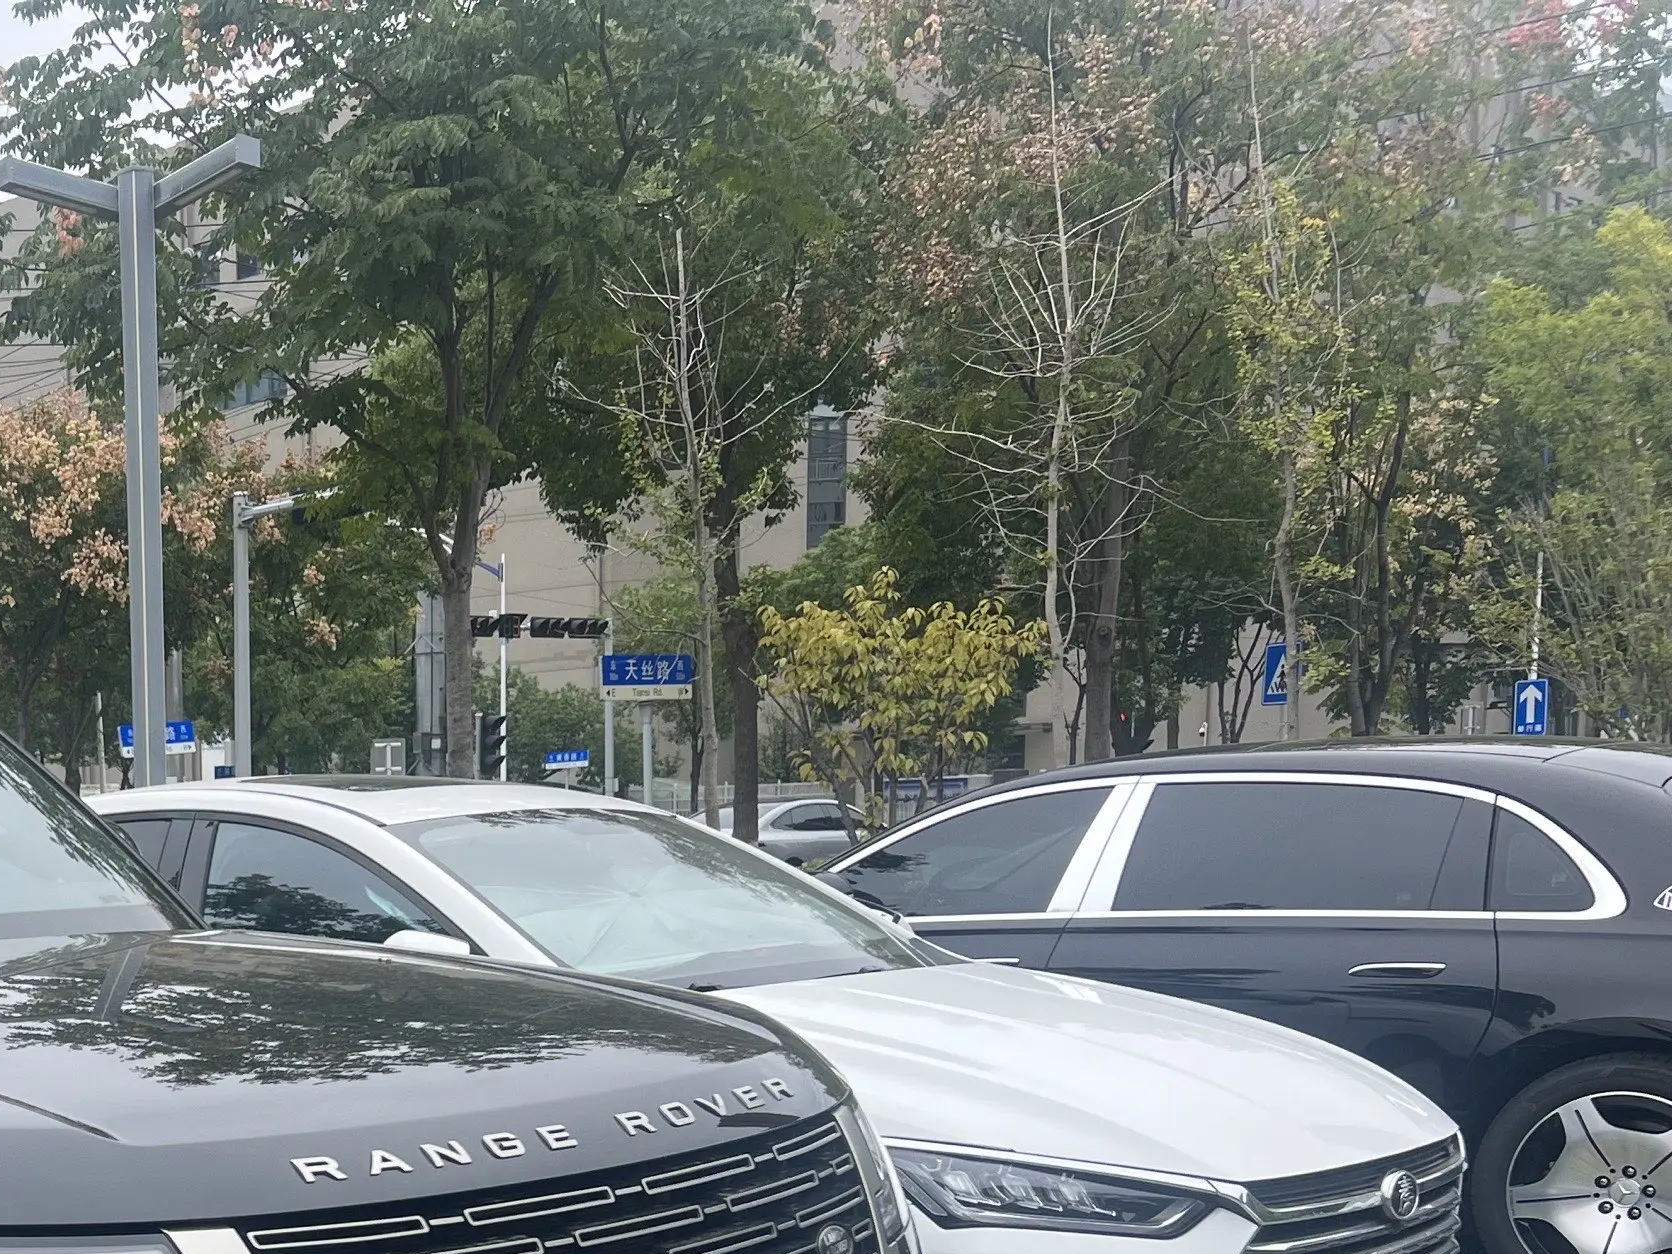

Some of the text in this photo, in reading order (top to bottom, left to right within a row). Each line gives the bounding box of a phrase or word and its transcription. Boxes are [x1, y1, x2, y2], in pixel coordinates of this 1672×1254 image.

[625, 660, 669, 680] 天丝路
[290, 1077, 794, 1183] RANGE ROVER
